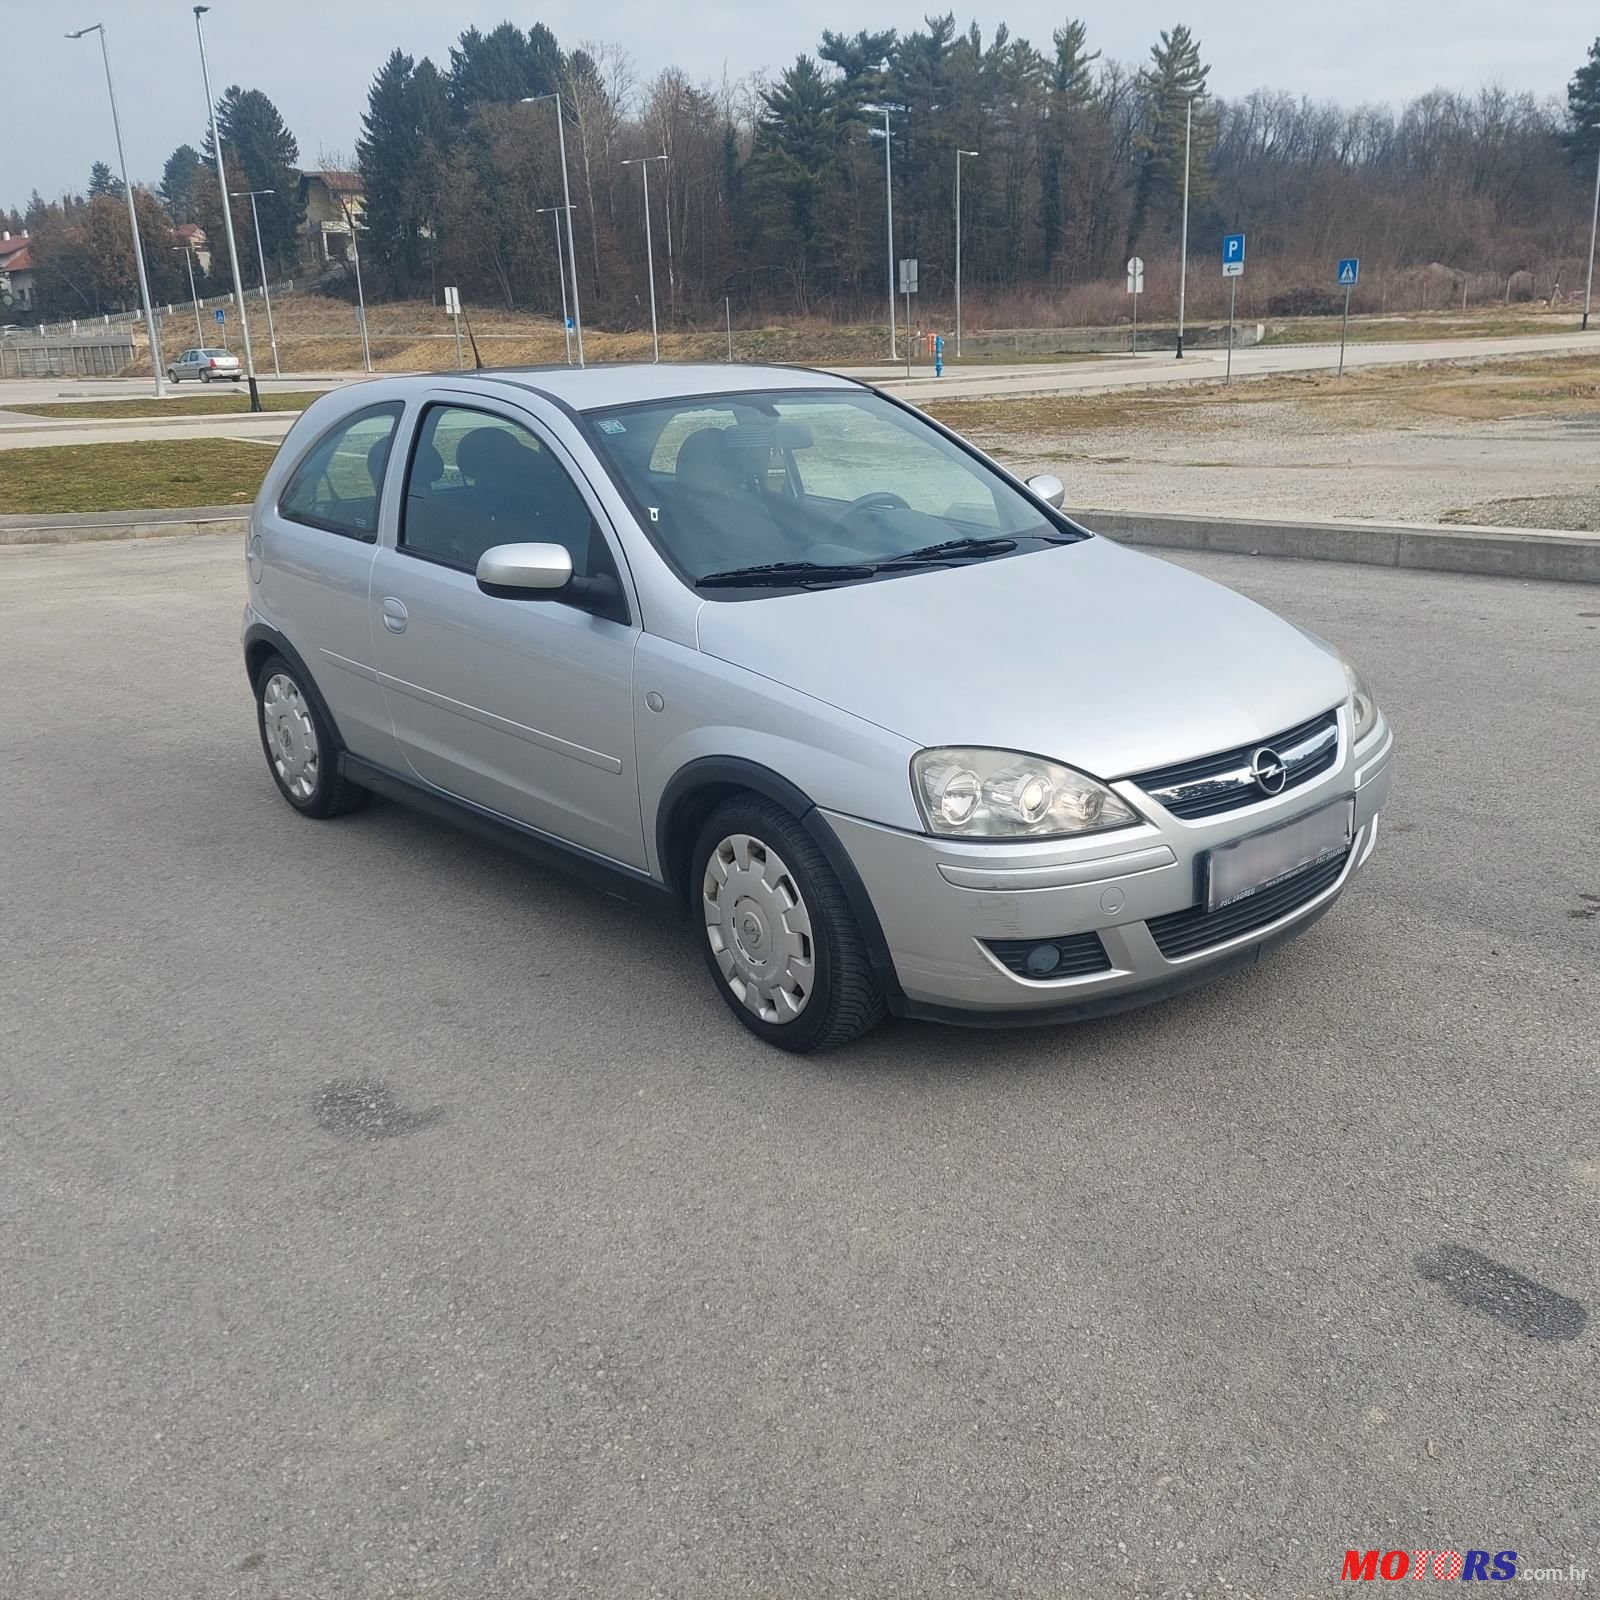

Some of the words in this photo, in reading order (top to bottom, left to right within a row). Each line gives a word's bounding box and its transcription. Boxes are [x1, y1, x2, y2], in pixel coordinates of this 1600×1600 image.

[1228, 240, 1239, 258] P
[1219, 898, 1232, 908] PSC
[1232, 887, 1256, 903] ZAGREB
